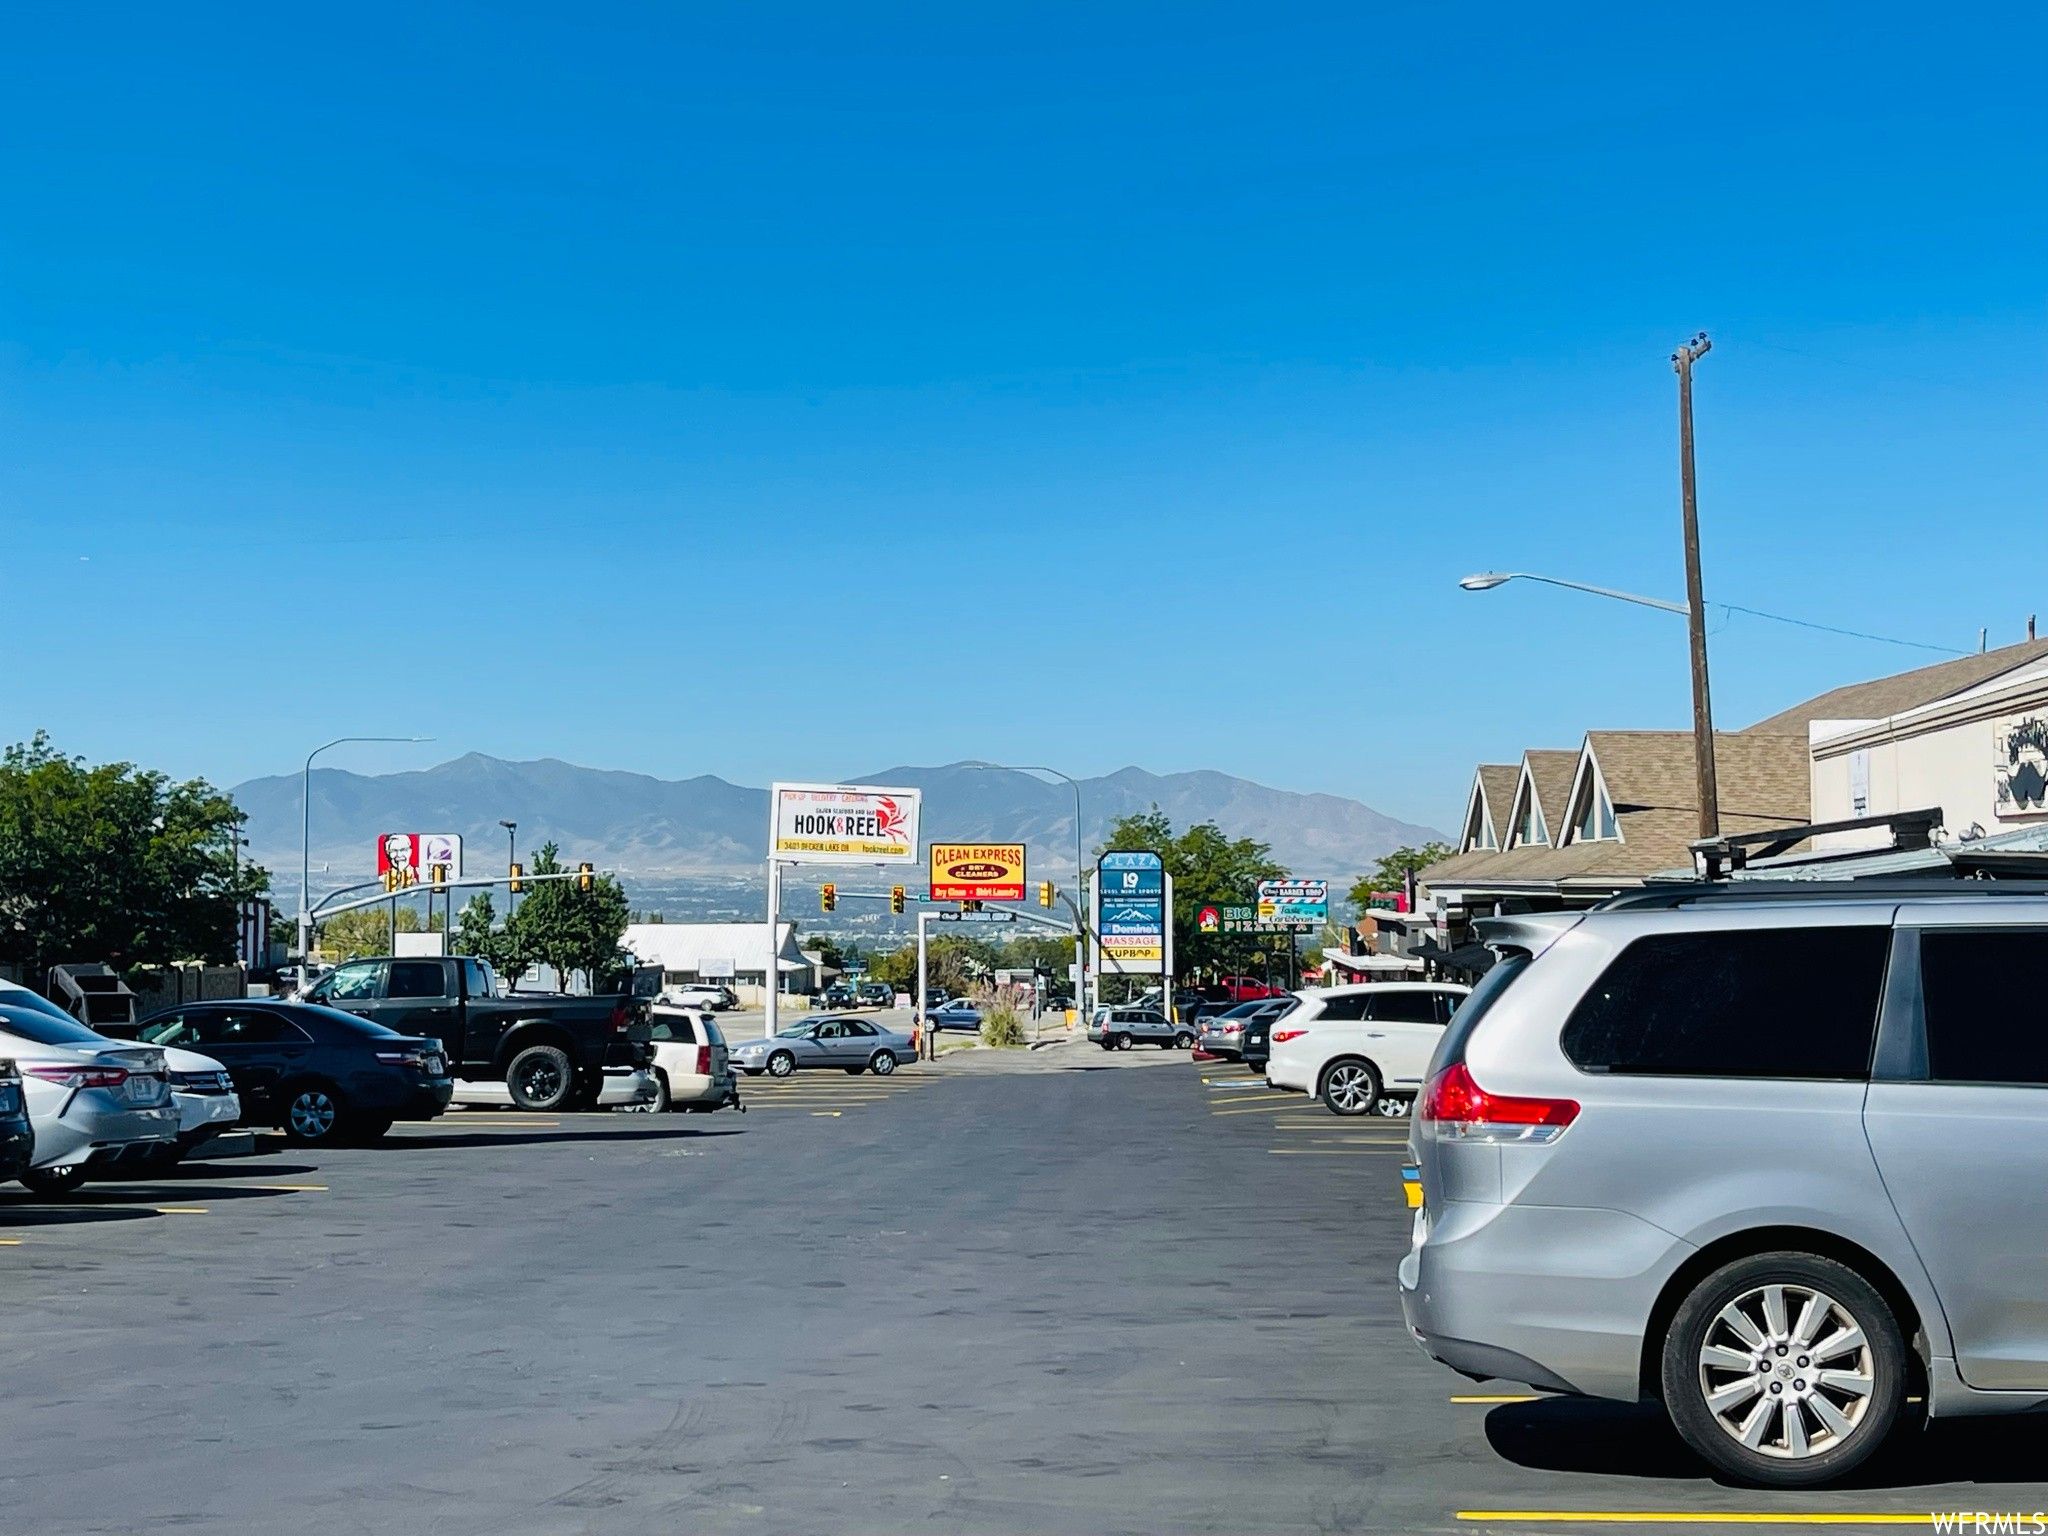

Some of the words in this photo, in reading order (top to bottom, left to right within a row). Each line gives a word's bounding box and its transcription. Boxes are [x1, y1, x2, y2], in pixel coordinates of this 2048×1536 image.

[935, 848, 970, 866] CLEAN
[973, 848, 1021, 866] EXPRESS
[1104, 857, 1158, 866] PLAZA
[427, 863, 453, 871] TO
[935, 888, 947, 898] Dry
[993, 888, 1020, 898] Laundry
[1279, 888, 1304, 896] BARBER
[1223, 907, 1251, 920] BIG
[1112, 923, 1159, 934] Domino's
[1223, 920, 1308, 932] PIZZERA
[1104, 937, 1157, 945] MASSAGE
